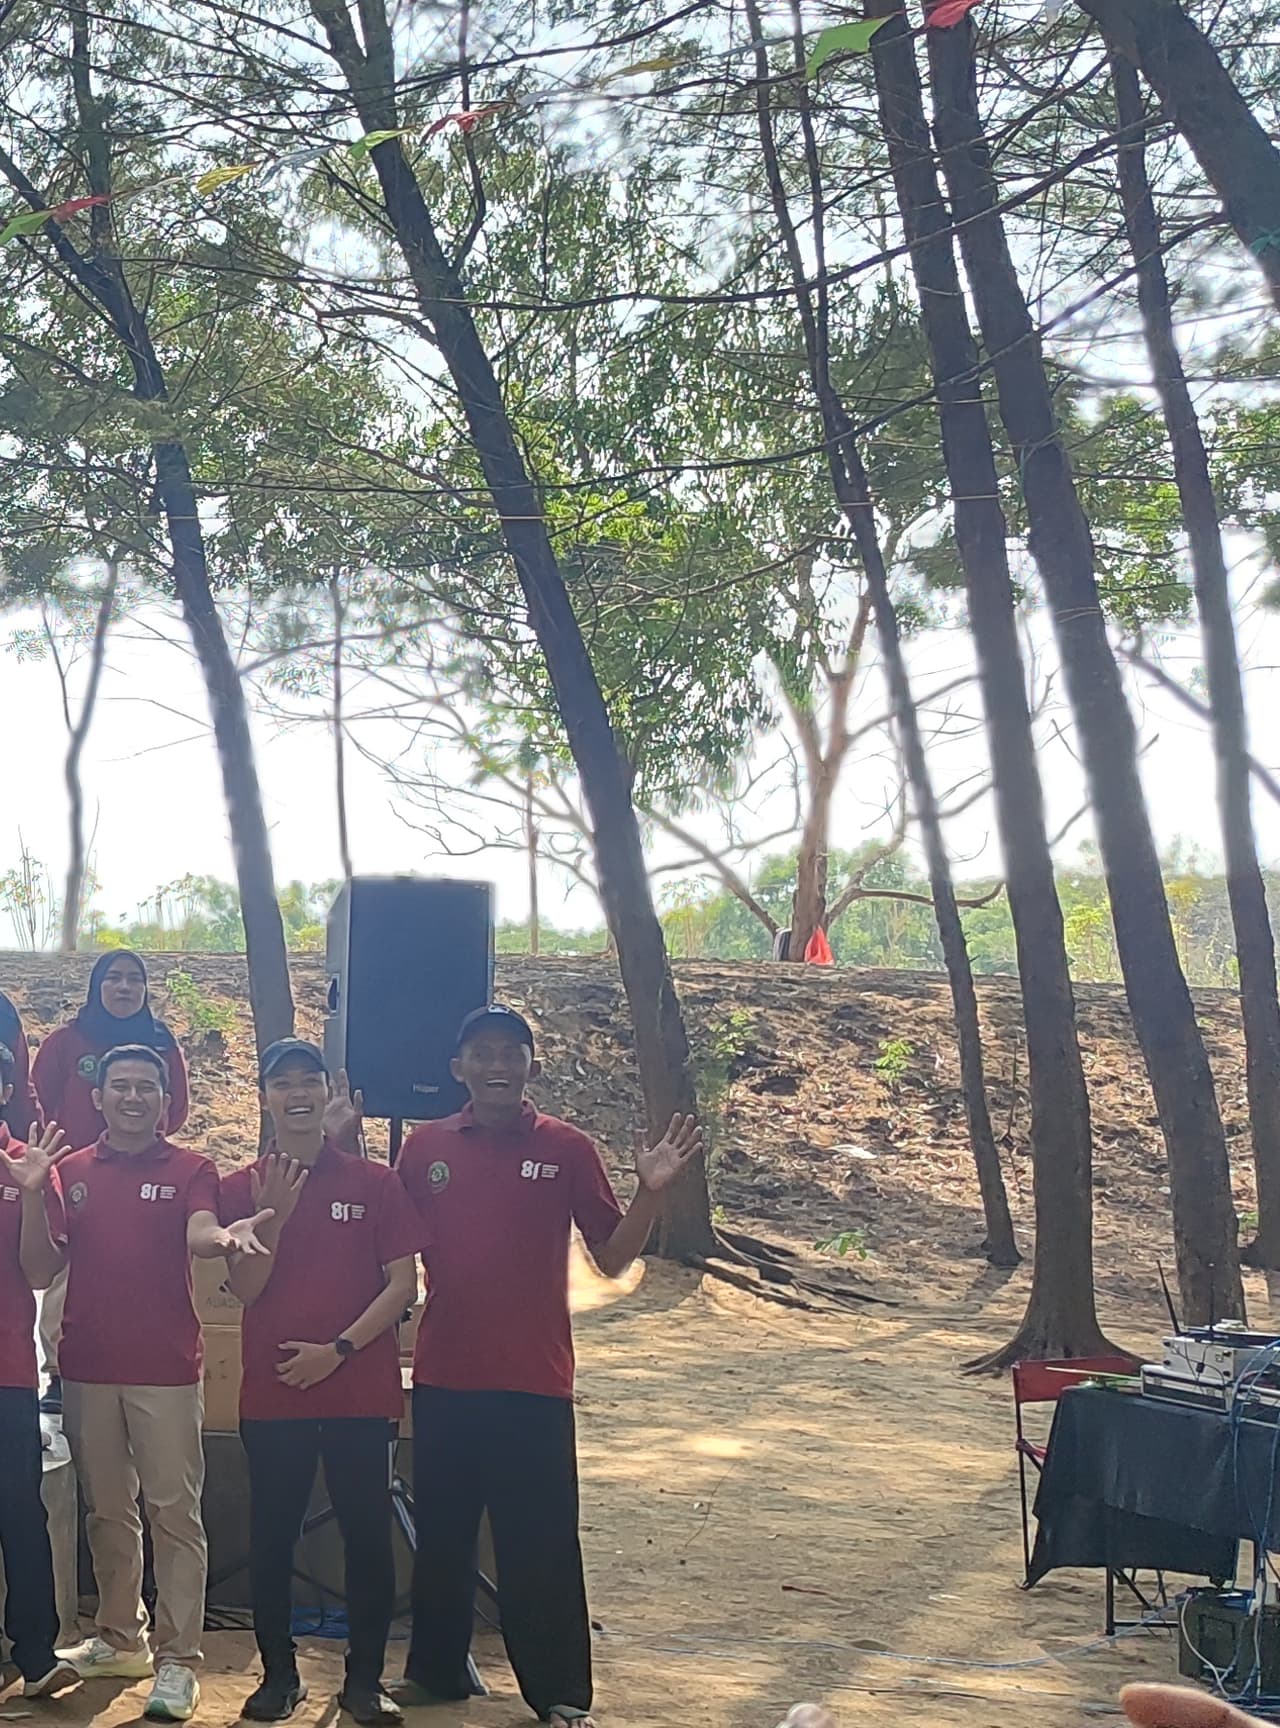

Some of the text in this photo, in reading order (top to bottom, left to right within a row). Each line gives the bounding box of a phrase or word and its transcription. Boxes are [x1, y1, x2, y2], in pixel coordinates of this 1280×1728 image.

[521, 1160, 542, 1180] 81
[140, 1183, 160, 1201] 81
[331, 1201, 350, 1222] 81
